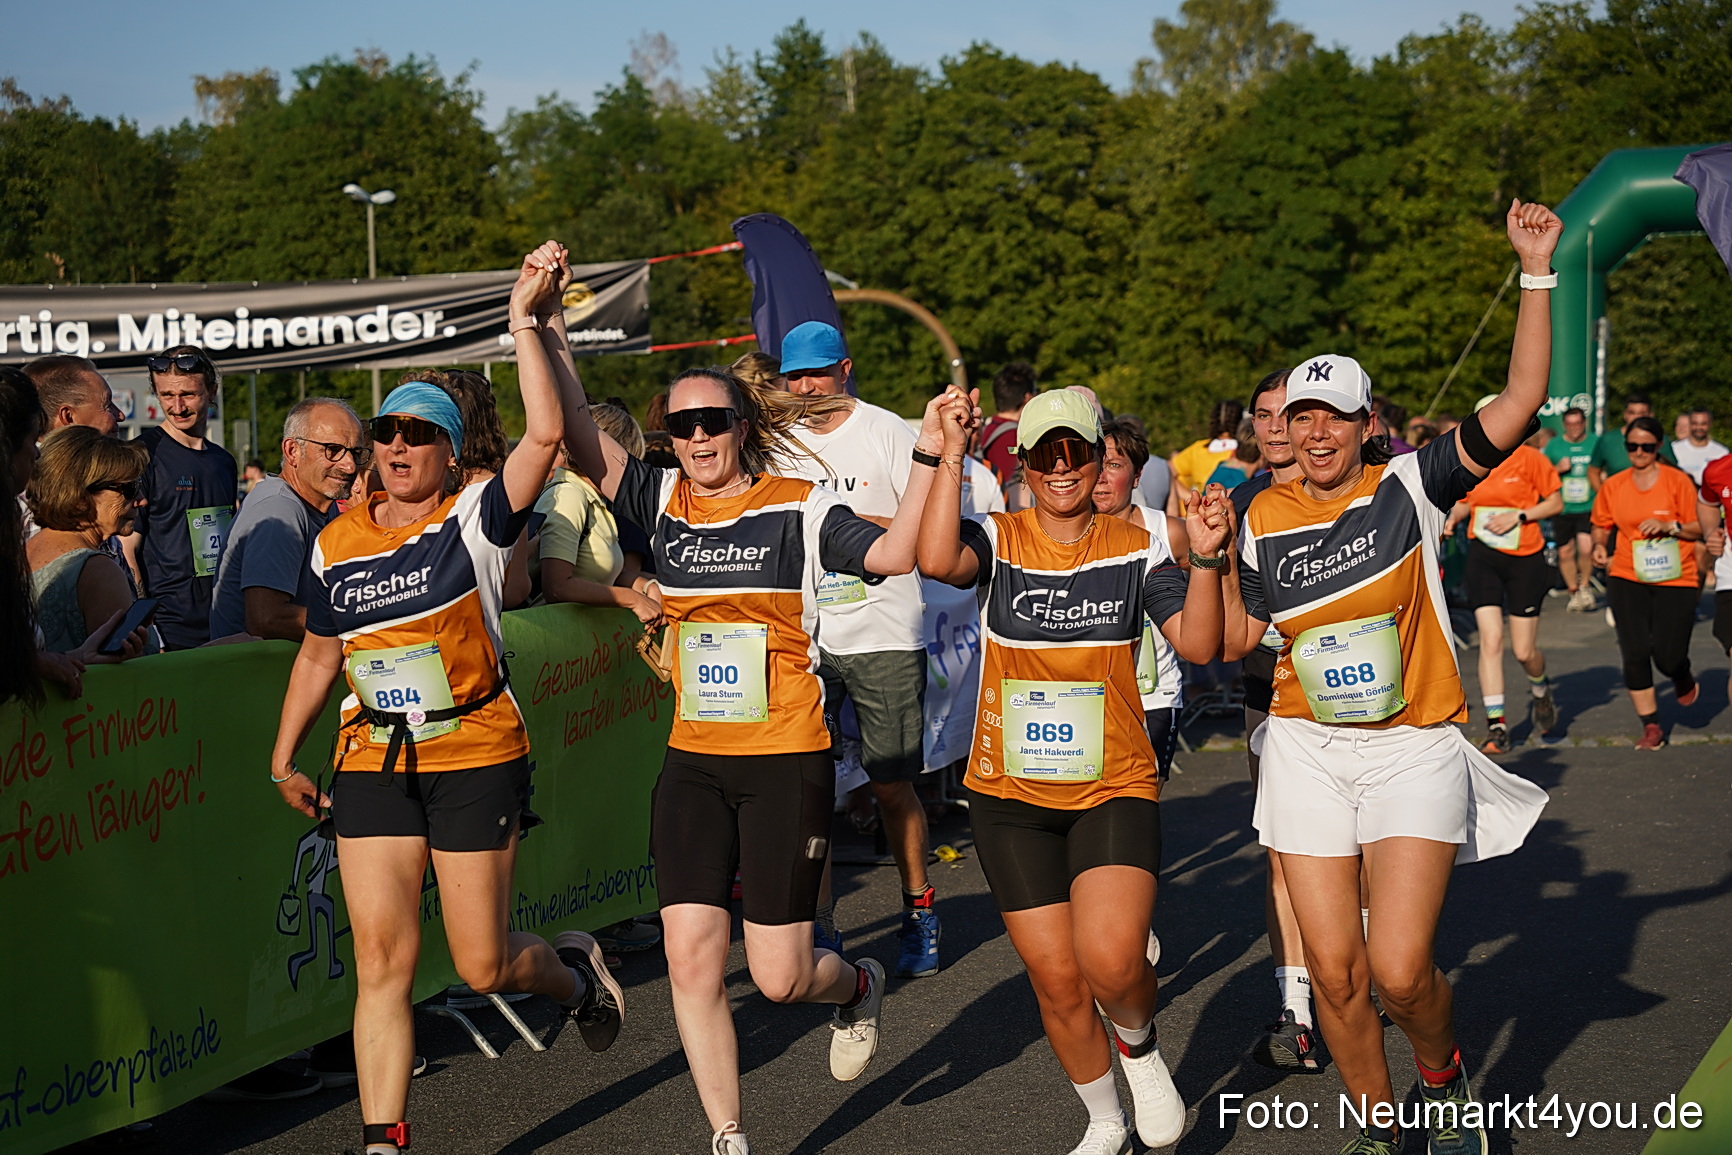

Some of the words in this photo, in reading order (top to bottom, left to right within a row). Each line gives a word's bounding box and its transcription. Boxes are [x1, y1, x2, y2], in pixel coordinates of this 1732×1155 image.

[0, 309, 106, 358] rtig.
[118, 306, 457, 353] Miteinander.
[1537, 396, 1571, 416] OK
[681, 543, 771, 563] Fischer
[687, 563, 762, 573] AUTOMOBILE
[1300, 547, 1377, 589] AUTOMOBILE
[344, 566, 431, 606] Fischer
[355, 584, 428, 614] AUTOMOBILE
[1032, 599, 1124, 621] Fischer
[1040, 616, 1119, 629] AUTOMOBILE
[698, 664, 738, 685] 900
[1324, 662, 1376, 688] 868
[375, 687, 421, 709] 884
[620, 676, 671, 723] länge
[698, 689, 718, 698] Laura
[719, 689, 743, 698] Sturm
[1316, 691, 1364, 702] Dominique
[1365, 682, 1395, 697] Görlich
[0, 716, 53, 790] de
[62, 696, 179, 769] Firmen
[1026, 722, 1074, 742] 869
[1020, 746, 1042, 756] Janet
[1044, 747, 1084, 756] Hakverdi
[87, 739, 206, 843] länger!
[418, 890, 440, 923] kt
